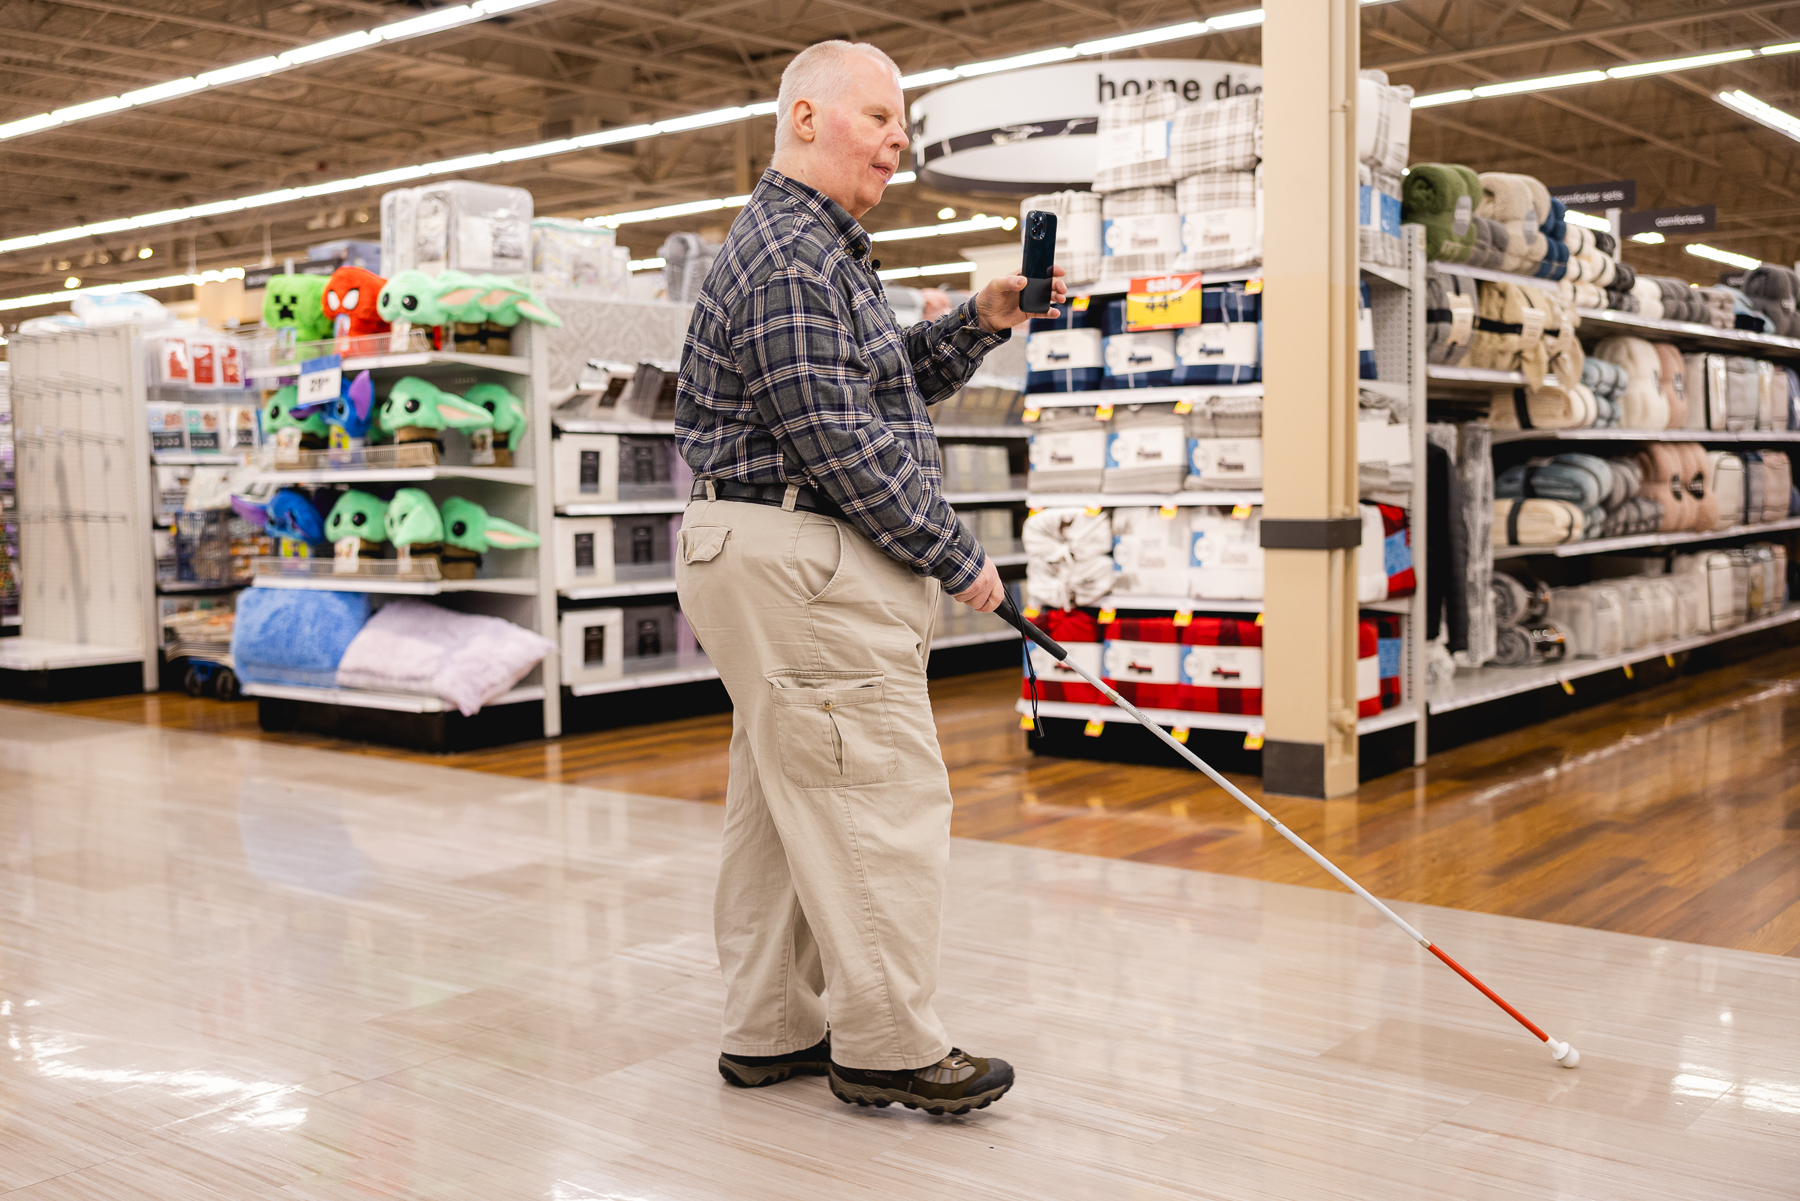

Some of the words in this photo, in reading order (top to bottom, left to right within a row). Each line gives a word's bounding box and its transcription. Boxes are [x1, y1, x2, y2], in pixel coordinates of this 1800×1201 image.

[1601, 189, 1625, 203] sets
[1655, 214, 1705, 228] comforters
[1146, 276, 1182, 293] sale
